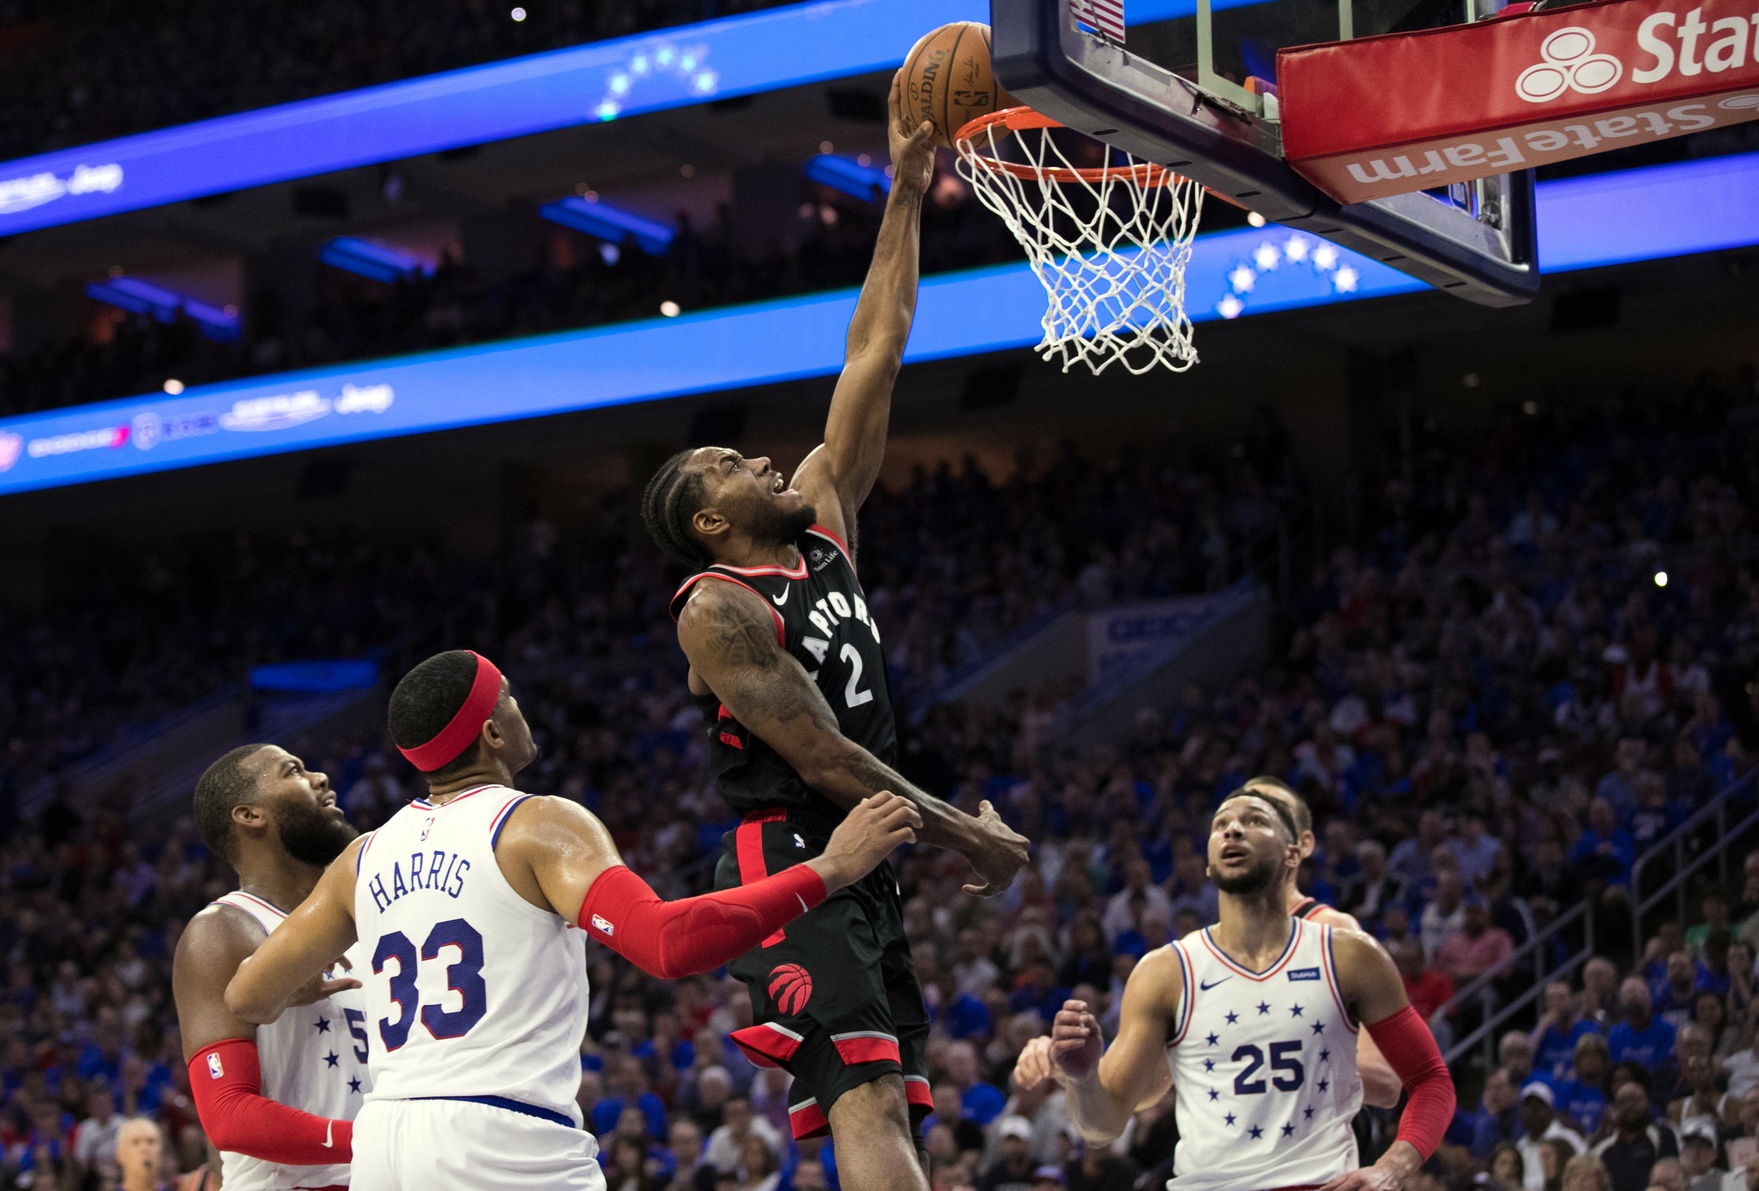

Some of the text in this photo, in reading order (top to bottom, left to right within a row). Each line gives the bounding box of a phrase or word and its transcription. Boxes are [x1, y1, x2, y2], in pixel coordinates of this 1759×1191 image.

[1631, 6, 1759, 84] Sta
[920, 49, 945, 122] PALDING
[1346, 103, 1715, 184] State Farm
[813, 550, 838, 572] Sun Life
[802, 591, 881, 681] APTOR
[839, 642, 874, 708] 2
[368, 850, 471, 914] HARRIS
[371, 918, 487, 1053] 33
[343, 1008, 369, 1065] 5
[1231, 1039, 1305, 1096] 25
